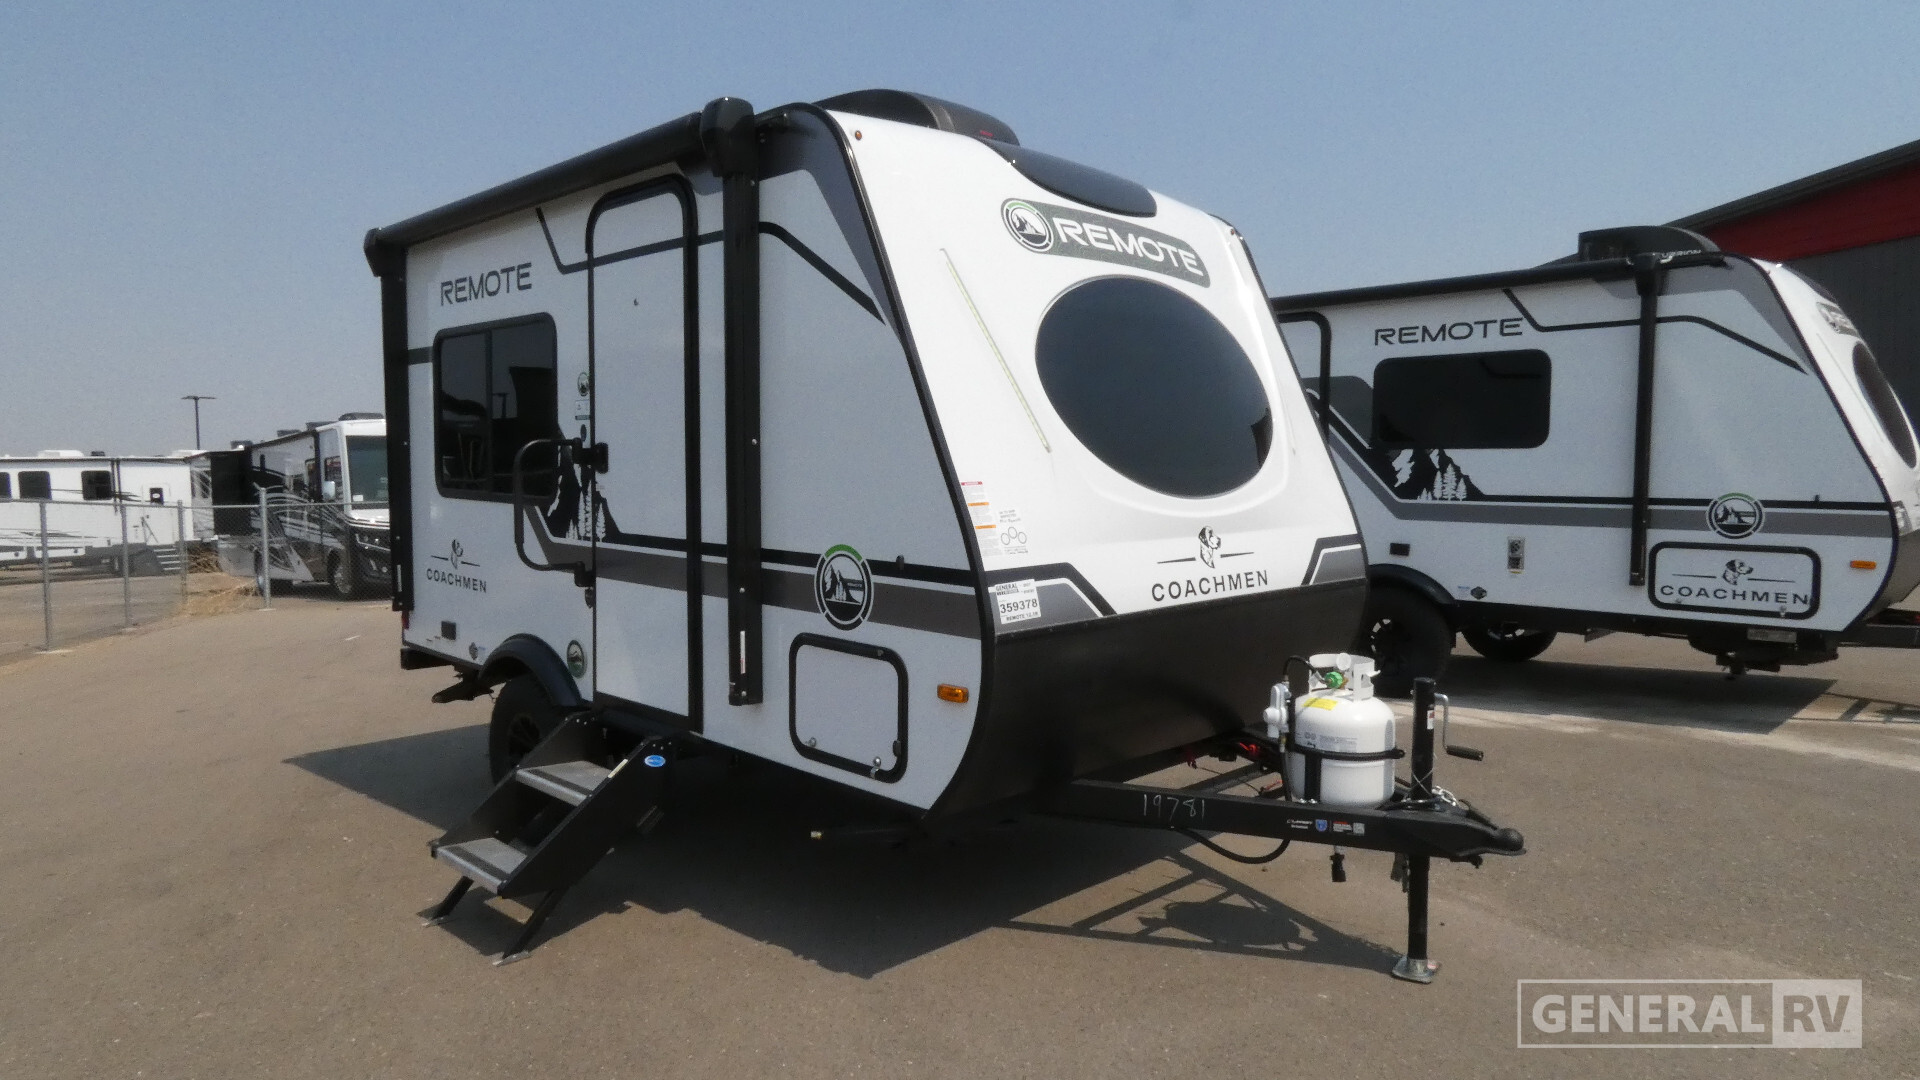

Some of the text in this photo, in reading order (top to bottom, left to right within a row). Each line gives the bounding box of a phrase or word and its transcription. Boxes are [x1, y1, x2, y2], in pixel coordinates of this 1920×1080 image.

[1052, 217, 1204, 277] REMOTE
[440, 262, 532, 306] REMOTE
[1374, 317, 1523, 346] REMOTE
[427, 567, 487, 594] COACHMEN
[1151, 569, 1268, 602] COACHMEN
[1659, 584, 1812, 606] COACHMEN
[999, 598, 1038, 614] 359378
[1143, 793, 1205, 822] 19781
